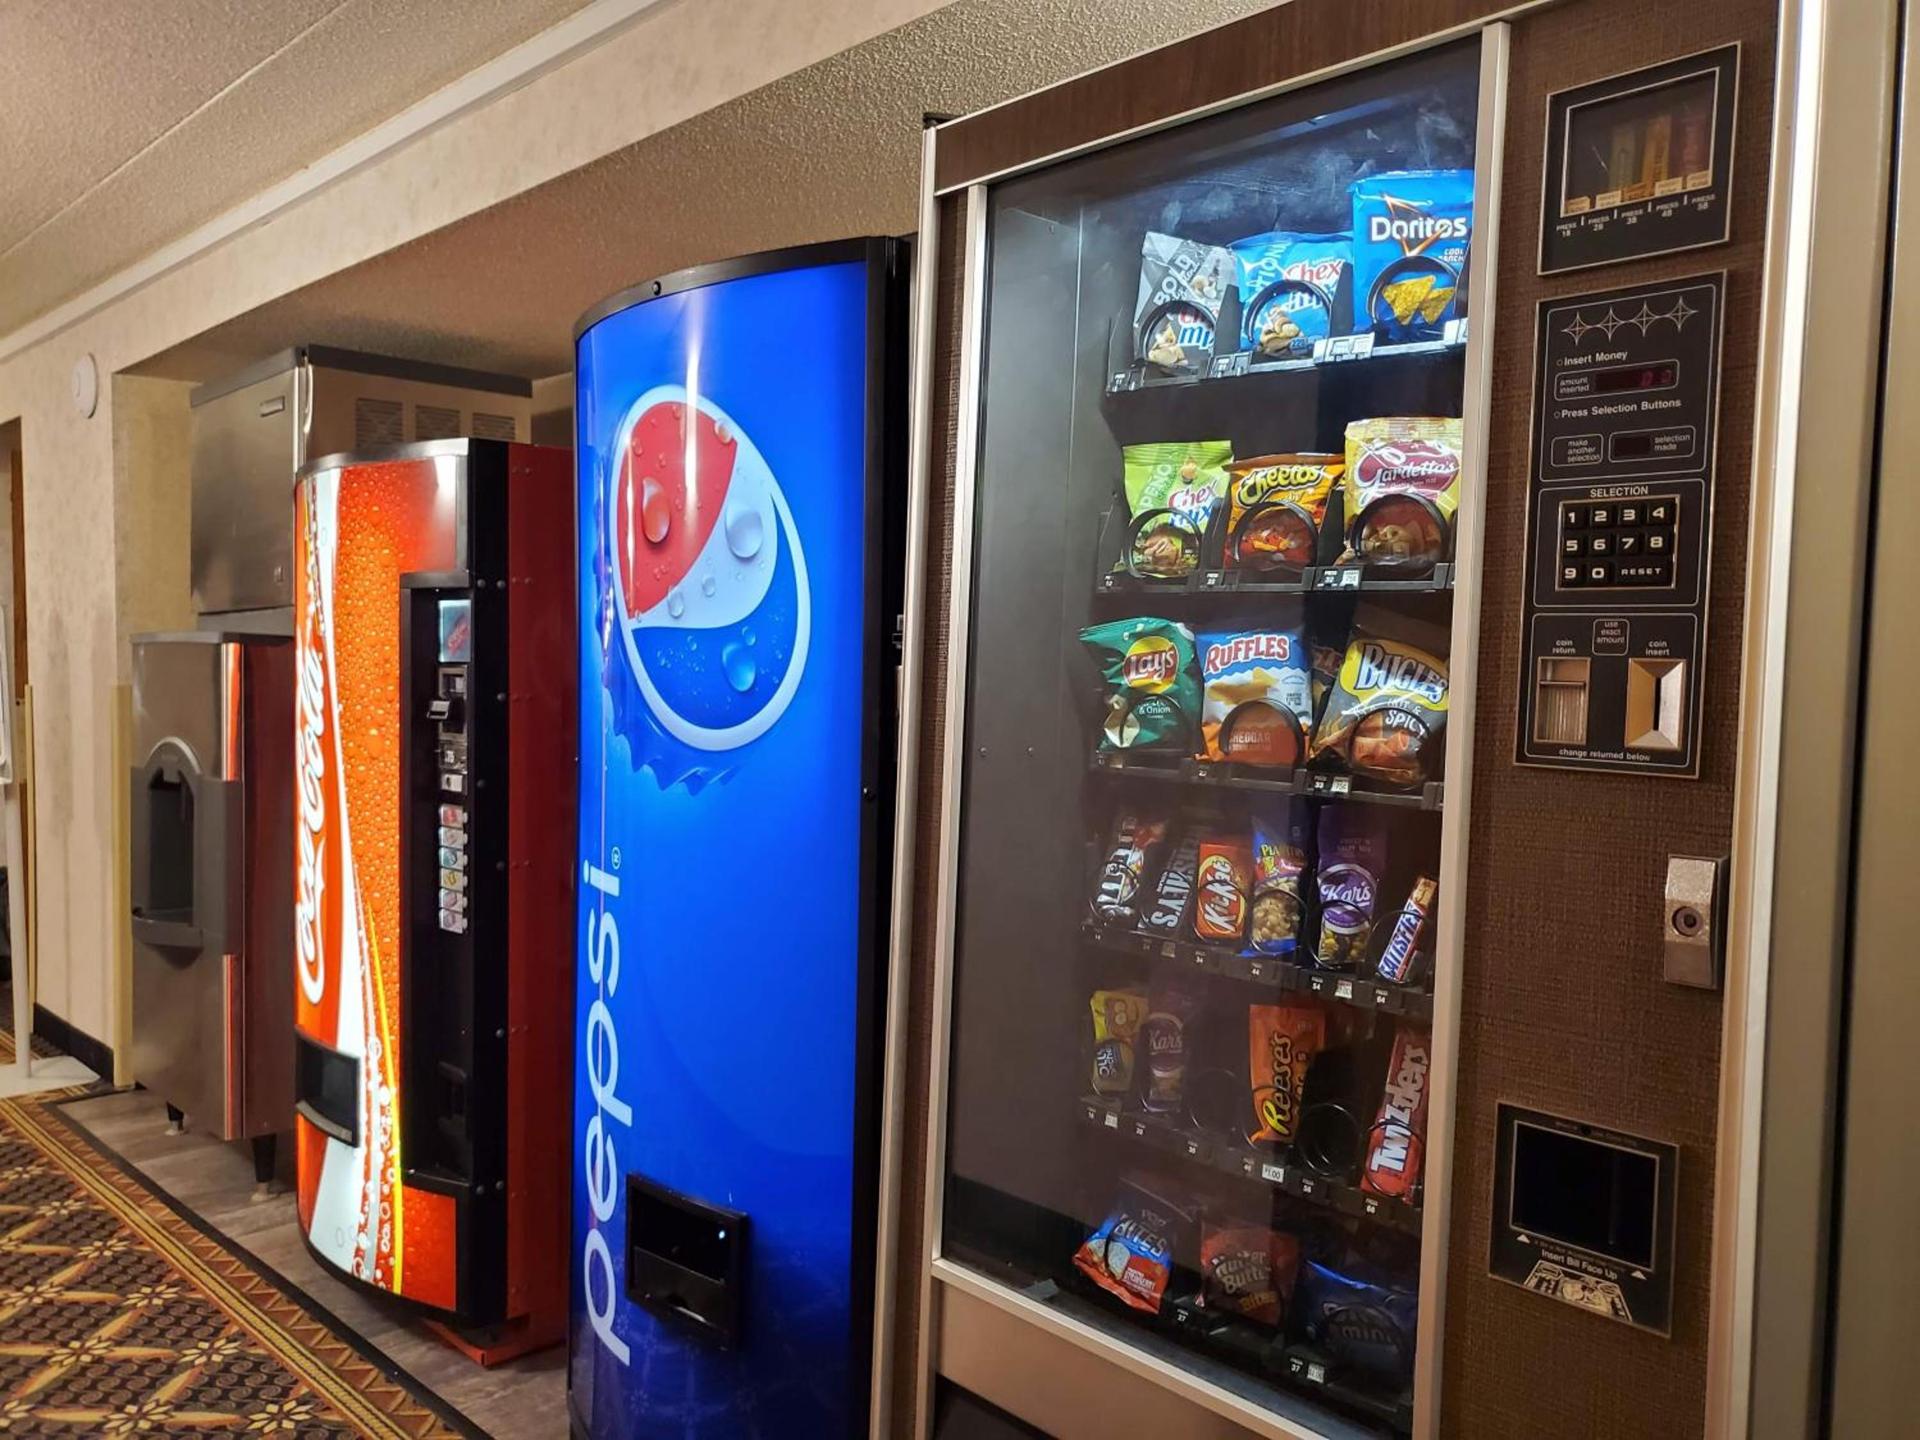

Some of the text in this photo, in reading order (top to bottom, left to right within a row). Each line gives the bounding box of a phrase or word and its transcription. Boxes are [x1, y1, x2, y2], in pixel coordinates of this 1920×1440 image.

[1371, 217, 1467, 241] Doritos
[1284, 259, 1345, 281] Chex
[1564, 350, 1628, 367] Insert Money
[1560, 375, 1588, 386] amount
[1559, 383, 1590, 394] inserted
[1561, 399, 1681, 419] Press Selection Buttons
[1567, 438, 1589, 447] make
[1654, 433, 1690, 443] selection
[1567, 445, 1596, 454] another
[1654, 443, 1677, 451] made
[1567, 453, 1600, 463] selection
[1590, 486, 1649, 498] SELECTION
[1568, 507, 1665, 523] 1 2 3 4
[1566, 536, 1663, 551] 5 6 7 8
[1564, 567, 1662, 579] 9 0 RESET
[1600, 627, 1622, 636] exact
[1556, 639, 1574, 647] coin
[1596, 635, 1625, 645] amount
[1648, 640, 1668, 648] coin
[1204, 633, 1290, 675] RUFFLES
[1552, 646, 1576, 655] return
[1645, 648, 1670, 657] insert
[1354, 643, 1449, 704] BUGLES
[1146, 706, 1171, 714] Onion
[1385, 709, 1426, 739] SPICY
[1559, 748, 1650, 762] change returned below
[583, 859, 632, 1366] pepsi
[1541, 1249, 1565, 1264] Insert
[1566, 1255, 1581, 1268] Bill
[1582, 1260, 1603, 1275] Face
[1604, 1267, 1618, 1280] Up
[1290, 1364, 1300, 1372] 37
